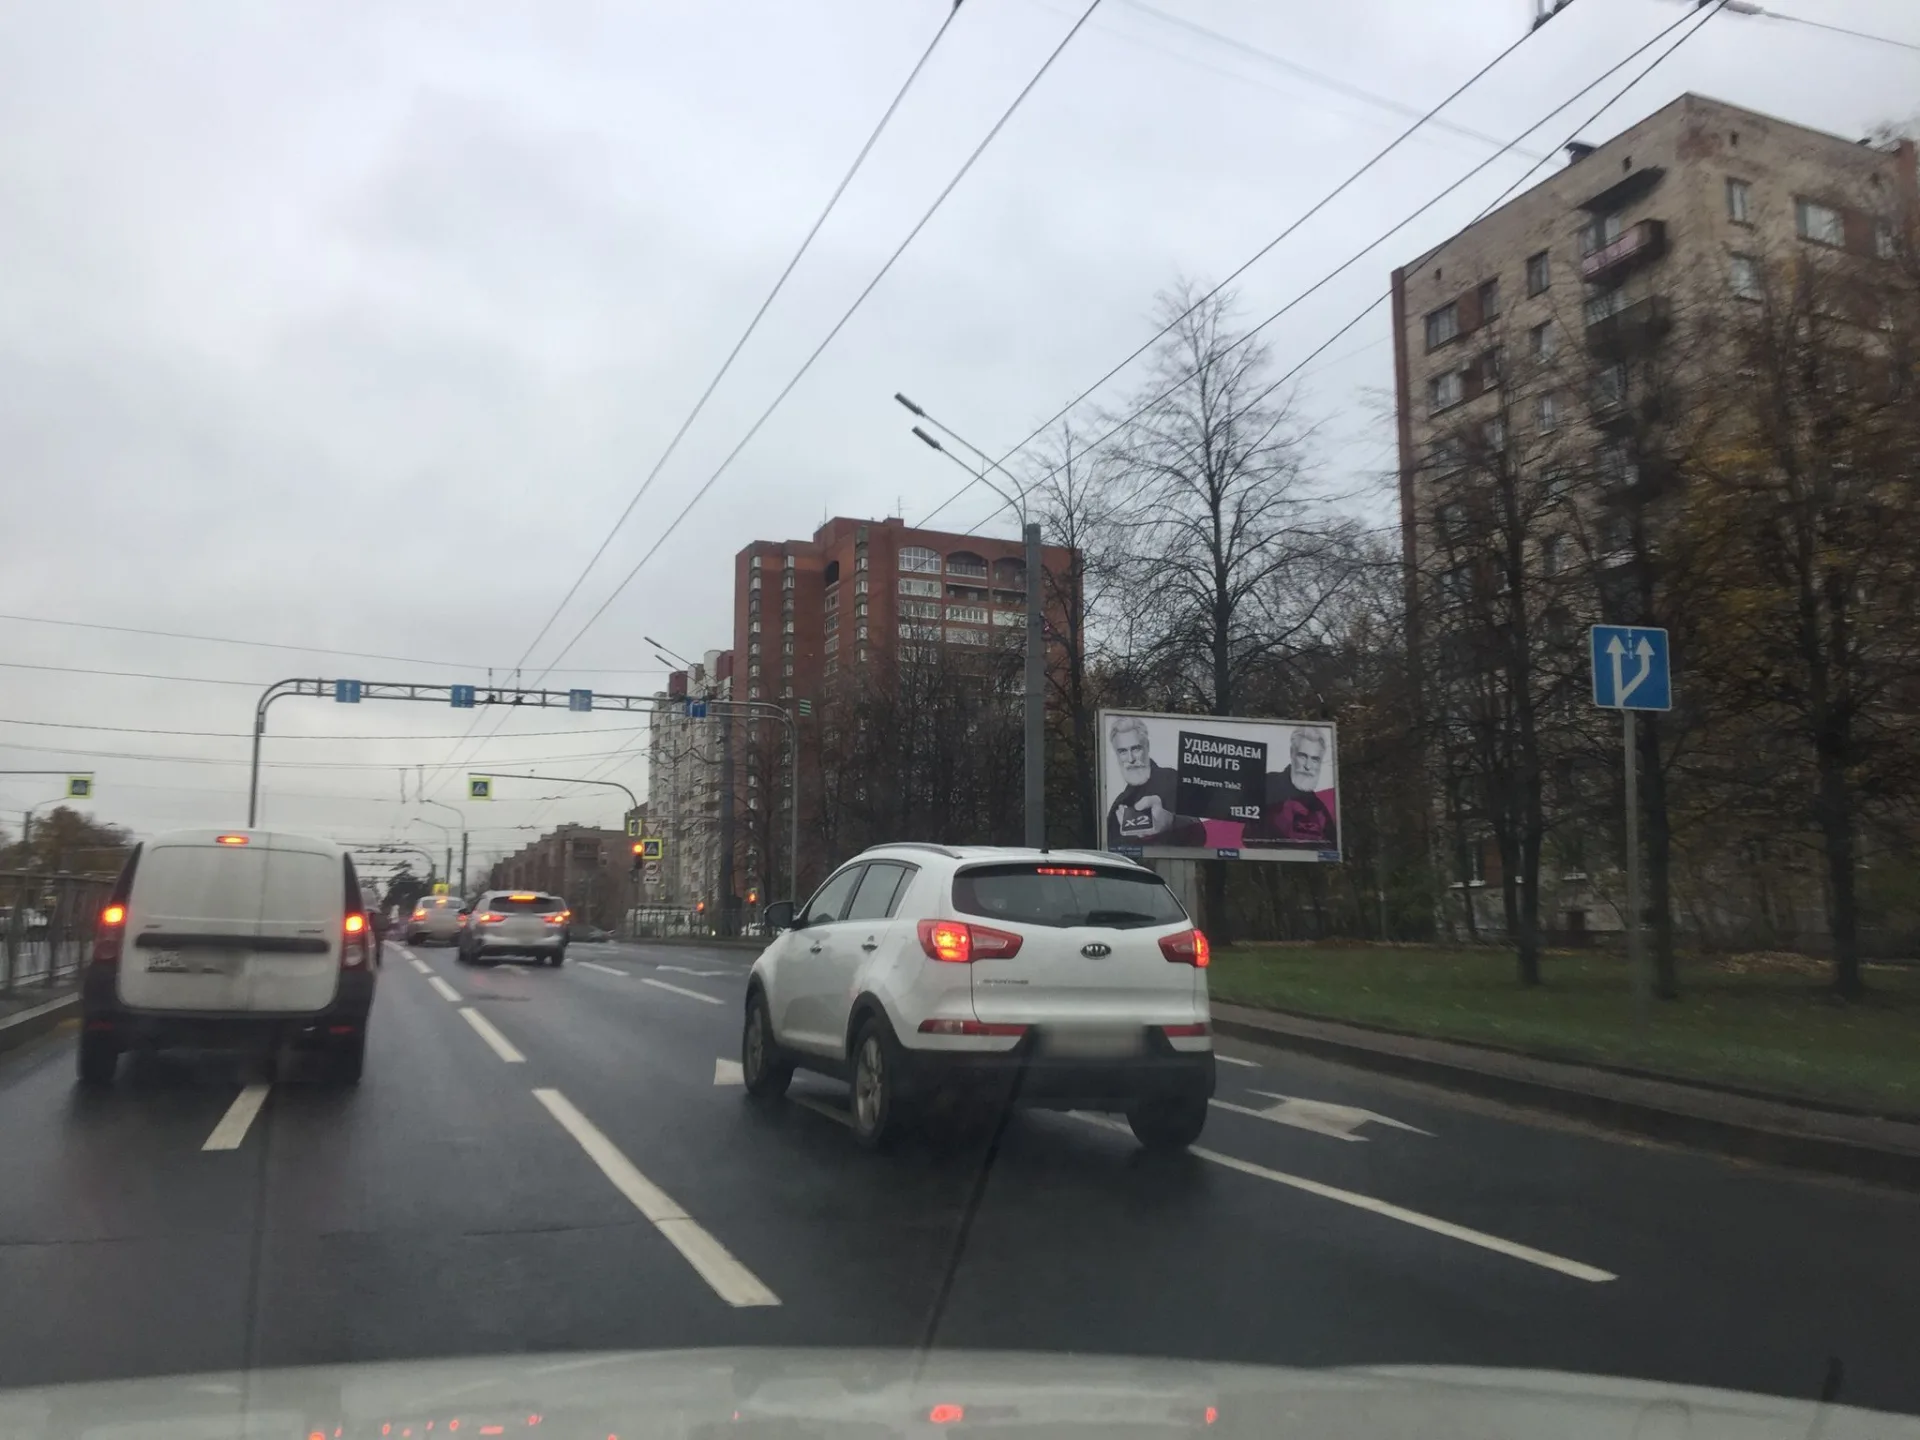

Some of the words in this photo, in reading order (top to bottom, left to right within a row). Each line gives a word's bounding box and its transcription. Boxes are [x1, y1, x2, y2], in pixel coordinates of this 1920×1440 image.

[1184, 738, 1262, 759] УДВАИВАЕМ
[1183, 752, 1222, 768] ВАШИ
[1224, 757, 1241, 771] ГБ
[1223, 780, 1242, 790] Tele2
[1229, 805, 1260, 819] TELE2
[1084, 945, 1107, 957] KIA
